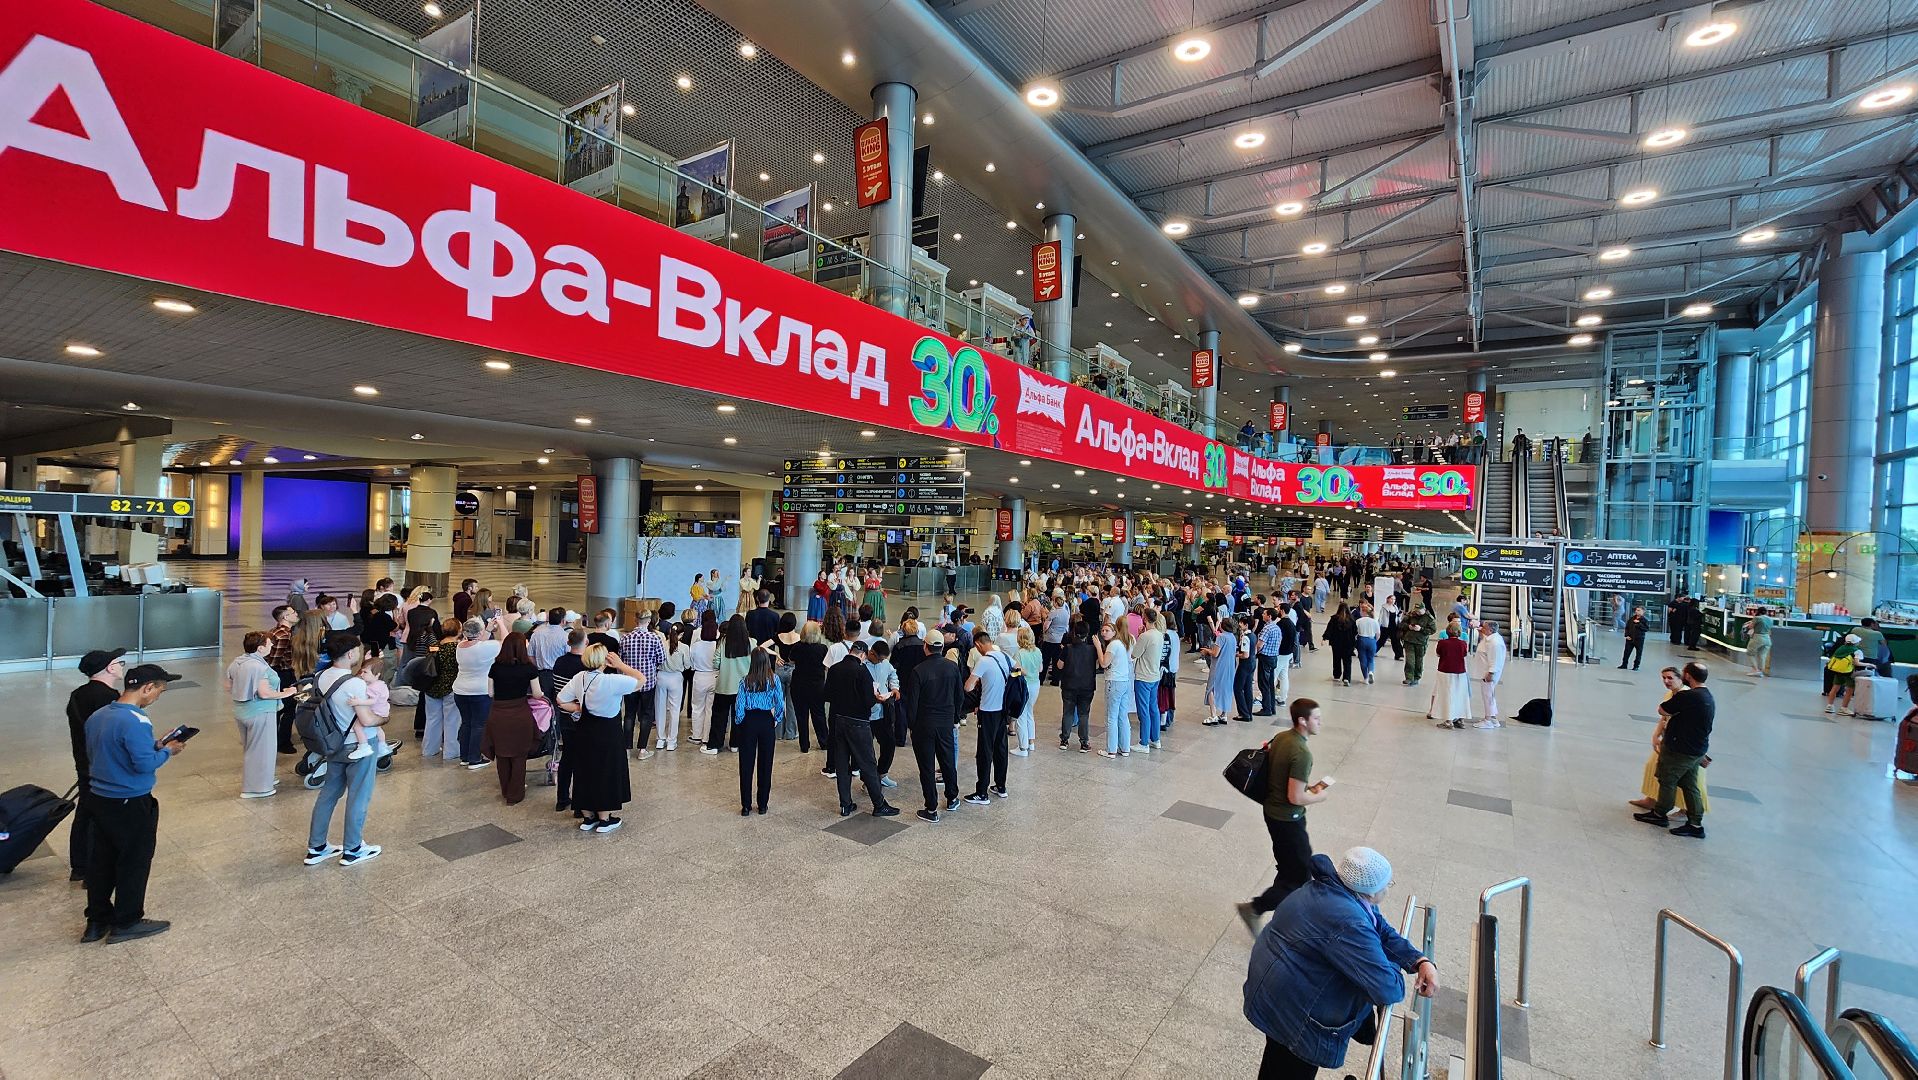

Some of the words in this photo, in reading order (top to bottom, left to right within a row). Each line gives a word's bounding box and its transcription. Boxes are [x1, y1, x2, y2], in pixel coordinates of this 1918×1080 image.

[861, 142, 880, 156] KING
[0, 34, 889, 406] Альфа-Вклад
[908, 335, 1000, 435] 30%
[1025, 386, 1046, 405] Альфа
[1046, 394, 1061, 408] Банк
[1075, 403, 1199, 480] Альфа-Вклад
[1251, 458, 1286, 484] Альфа
[1417, 470, 1470, 497] 30%
[1250, 477, 1282, 503] Вклад
[1296, 466, 1363, 503] 30%
[1382, 482, 1415, 491] Альфа
[1382, 489, 1414, 497] Вклад
[110, 499, 131, 512] 82
[146, 501, 166, 513] 71
[1757, 588, 1784, 596] HOTEL
